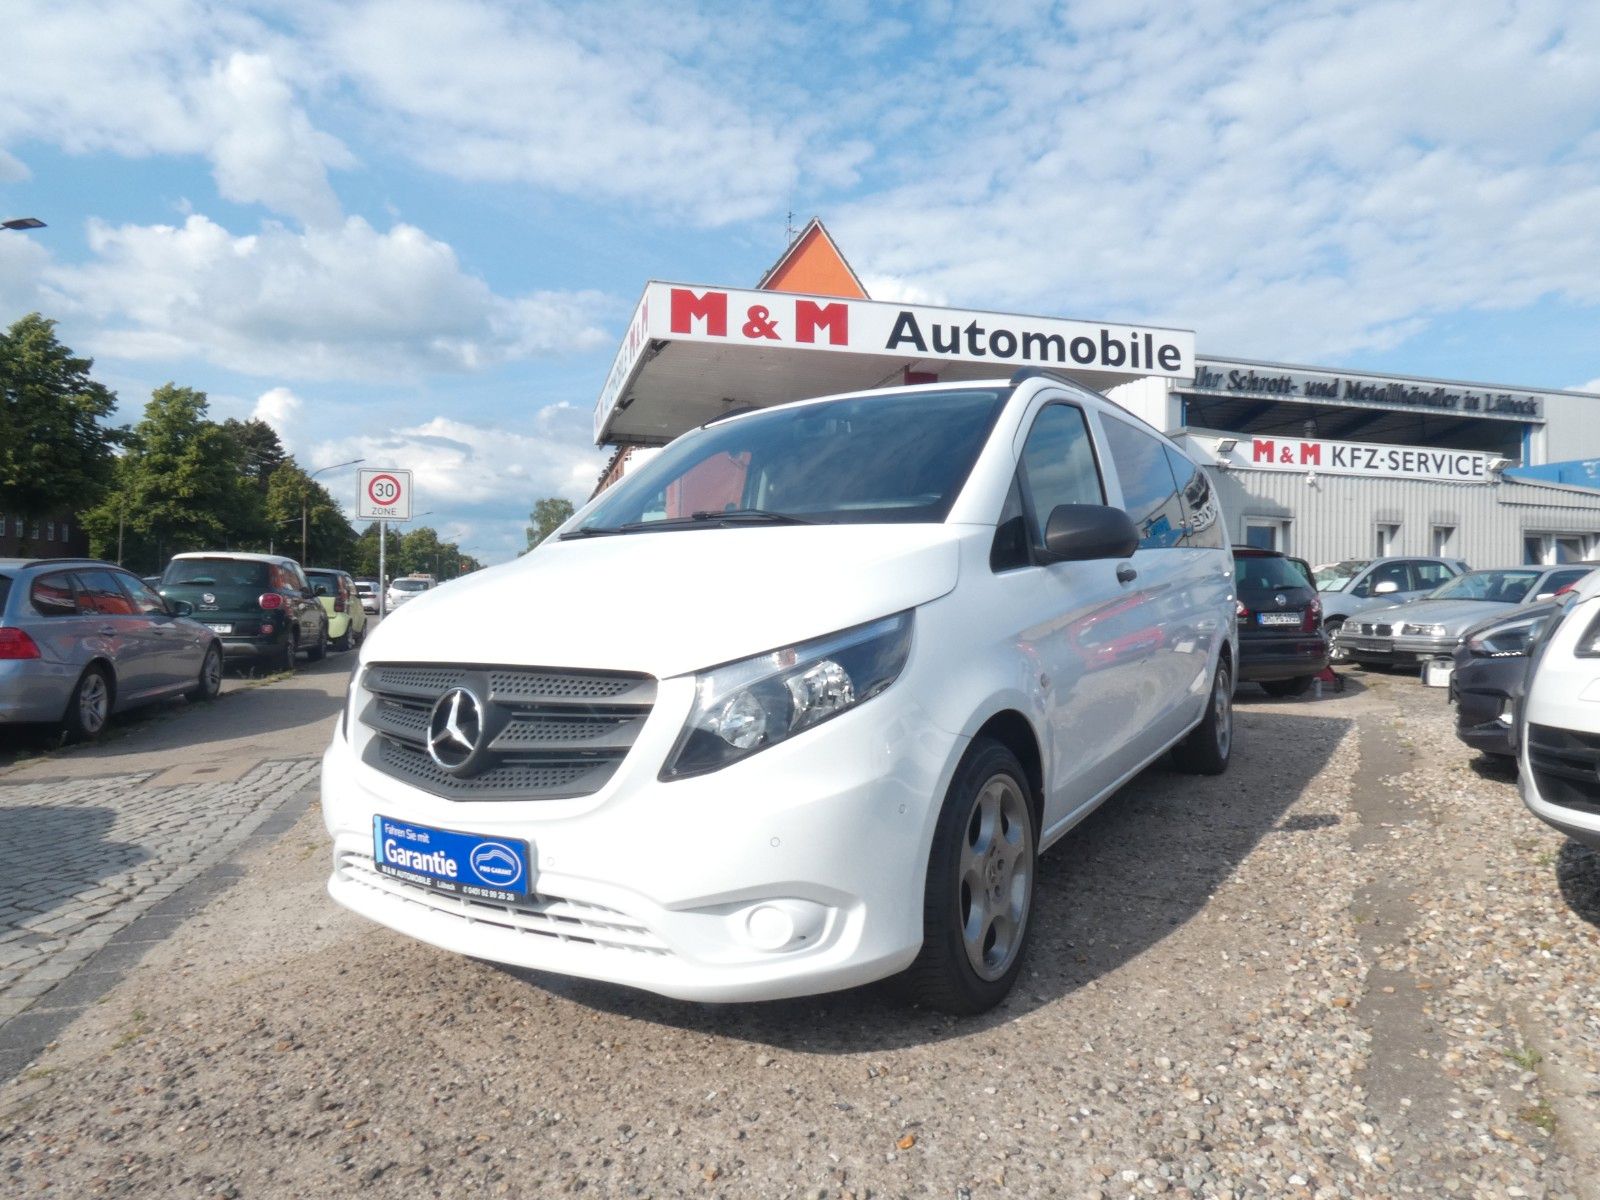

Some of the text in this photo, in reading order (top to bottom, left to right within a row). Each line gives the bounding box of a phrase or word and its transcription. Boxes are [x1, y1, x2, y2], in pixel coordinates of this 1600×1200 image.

[670, 288, 1182, 372] M & M Automobile
[1305, 377, 1340, 398] und
[1253, 439, 1485, 477] M & M KFZ-SERVICE
[375, 483, 394, 497] 30
[371, 507, 397, 516] ZONE
[384, 823, 406, 838] Fahren
[405, 829, 417, 841] Sie
[385, 838, 458, 878] Garantie
